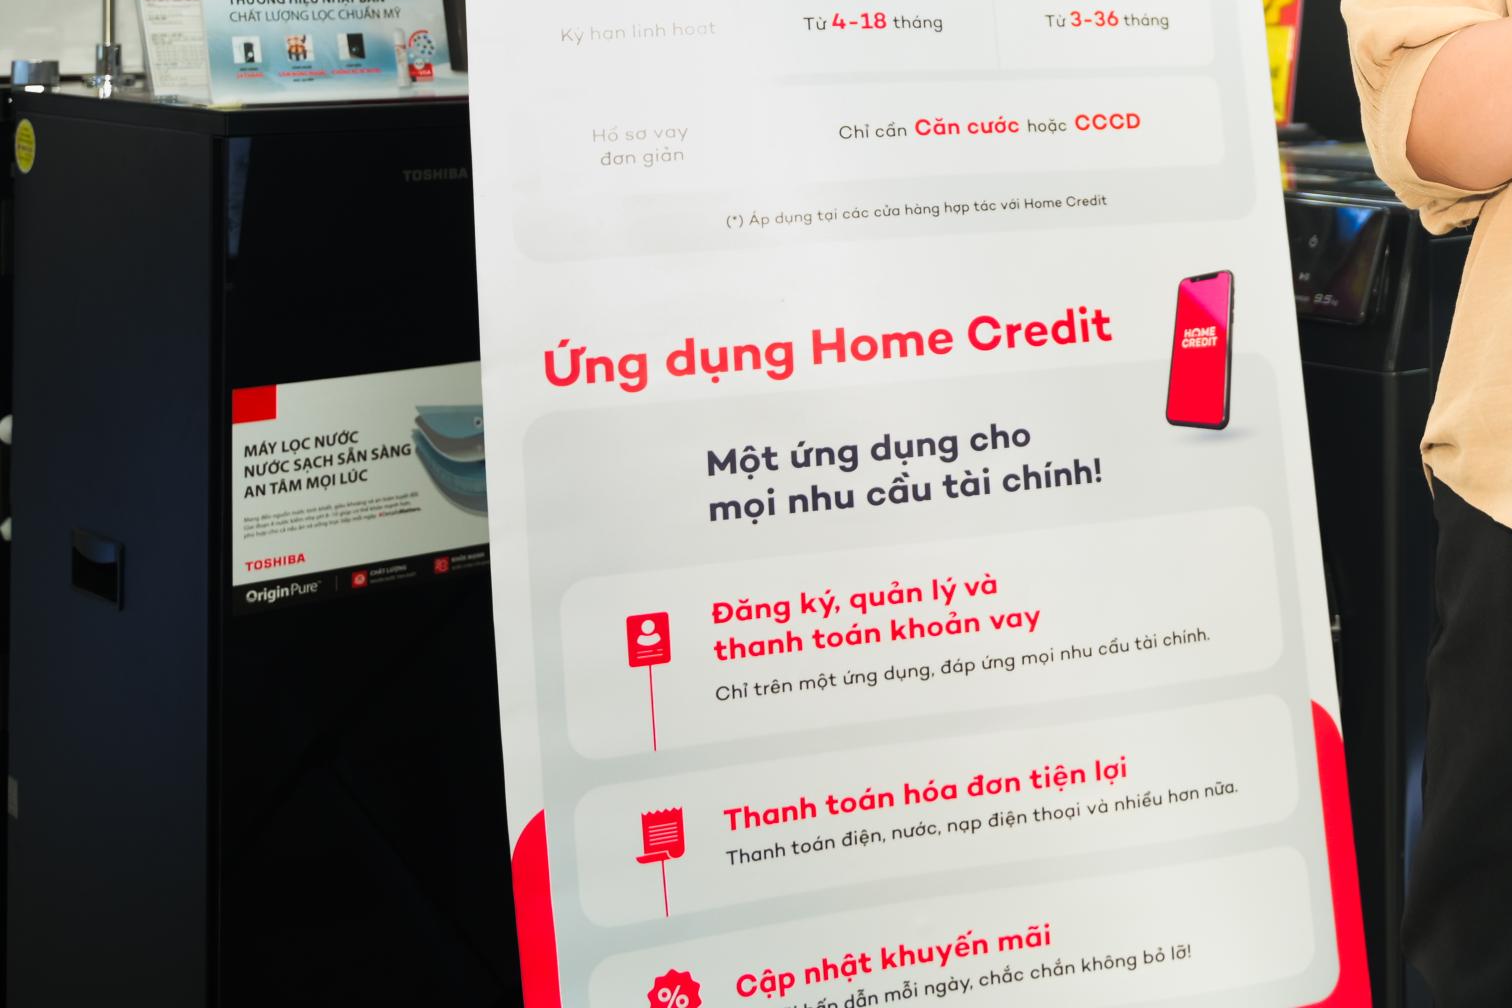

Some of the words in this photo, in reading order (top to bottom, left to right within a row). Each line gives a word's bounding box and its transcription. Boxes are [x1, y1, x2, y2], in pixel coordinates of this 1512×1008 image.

[803, 15, 828, 32] Từ
[831, 12, 888, 31] 4-18
[892, 13, 944, 34] tháng
[1045, 12, 1068, 29] Từ
[1070, 9, 1120, 30] 3-36
[1123, 11, 1170, 33] tháng
[654, 127, 688, 142] vay
[838, 120, 871, 141] Chỉ
[874, 120, 908, 139] cần
[914, 114, 962, 138] Căn
[965, 112, 1021, 136] cước
[1026, 116, 1068, 138] hoặc
[1073, 112, 1142, 132] CCCD
[600, 151, 637, 167] đơn
[748, 210, 770, 229] Áp
[774, 208, 813, 227] dụng
[817, 206, 838, 222] tại
[842, 205, 869, 220] các
[873, 204, 901, 219] cửa
[904, 201, 940, 218] hàng
[944, 199, 970, 216] hợp
[973, 199, 997, 213] tác
[1000, 197, 1021, 211] với
[1024, 196, 1063, 210] Home
[1065, 194, 1108, 209] Credit
[1181, 336, 1218, 349] CREDIT
[1183, 325, 1217, 338] HOME
[543, 335, 649, 393] Ứng
[665, 334, 795, 385] dụng
[811, 325, 954, 366] Home
[967, 306, 1114, 353] Credit
[243, 440, 278, 459] MÁY
[281, 436, 312, 455] LỌC
[314, 430, 360, 450] NƯỚC
[243, 459, 291, 479] NƯỚC
[293, 453, 335, 475] SẠCH
[370, 443, 413, 462] SÀNG
[706, 446, 779, 482] Một
[789, 439, 860, 477] ứng
[870, 432, 959, 468] dụng
[969, 422, 1032, 453] cho
[243, 483, 267, 499] AN
[269, 476, 303, 496] TÂM
[305, 472, 337, 493] MỌI
[339, 467, 369, 486] LÚC
[708, 483, 777, 527] mọi
[787, 480, 856, 516] nhu
[865, 472, 933, 506] cầu
[942, 466, 993, 499] tài
[1002, 457, 1103, 494] chính!
[244, 552, 307, 572] TOSHIBA
[711, 596, 791, 626] Đăng
[800, 590, 841, 618] ký,
[849, 580, 924, 616] quản
[931, 578, 958, 606] lý
[963, 574, 999, 598] và
[713, 630, 804, 662] thanh
[812, 621, 882, 650] toán
[890, 610, 981, 643] khoản
[989, 607, 1042, 634] vay
[715, 679, 749, 703] Chỉ
[753, 677, 794, 698] trên
[798, 670, 837, 694] một
[842, 665, 879, 691] ứng
[883, 661, 936, 685] dụng,
[940, 656, 977, 679] đáp
[981, 651, 1016, 674] ứng
[1021, 647, 1056, 670] mọi
[1059, 642, 1094, 662] nhu
[1097, 636, 1131, 657] cầu
[1134, 631, 1159, 651] tài
[1162, 626, 1212, 648] chính.
[724, 801, 818, 832] Thanh
[825, 791, 896, 816] toán
[903, 780, 959, 805] hóa
[966, 771, 1023, 800] đơn
[1028, 766, 1088, 793] tiện
[1094, 755, 1129, 785] lợi
[736, 969, 797, 1000] Cập
[804, 955, 873, 988] nhật
[880, 928, 990, 972] khuyến
[997, 922, 1053, 954] mãi
